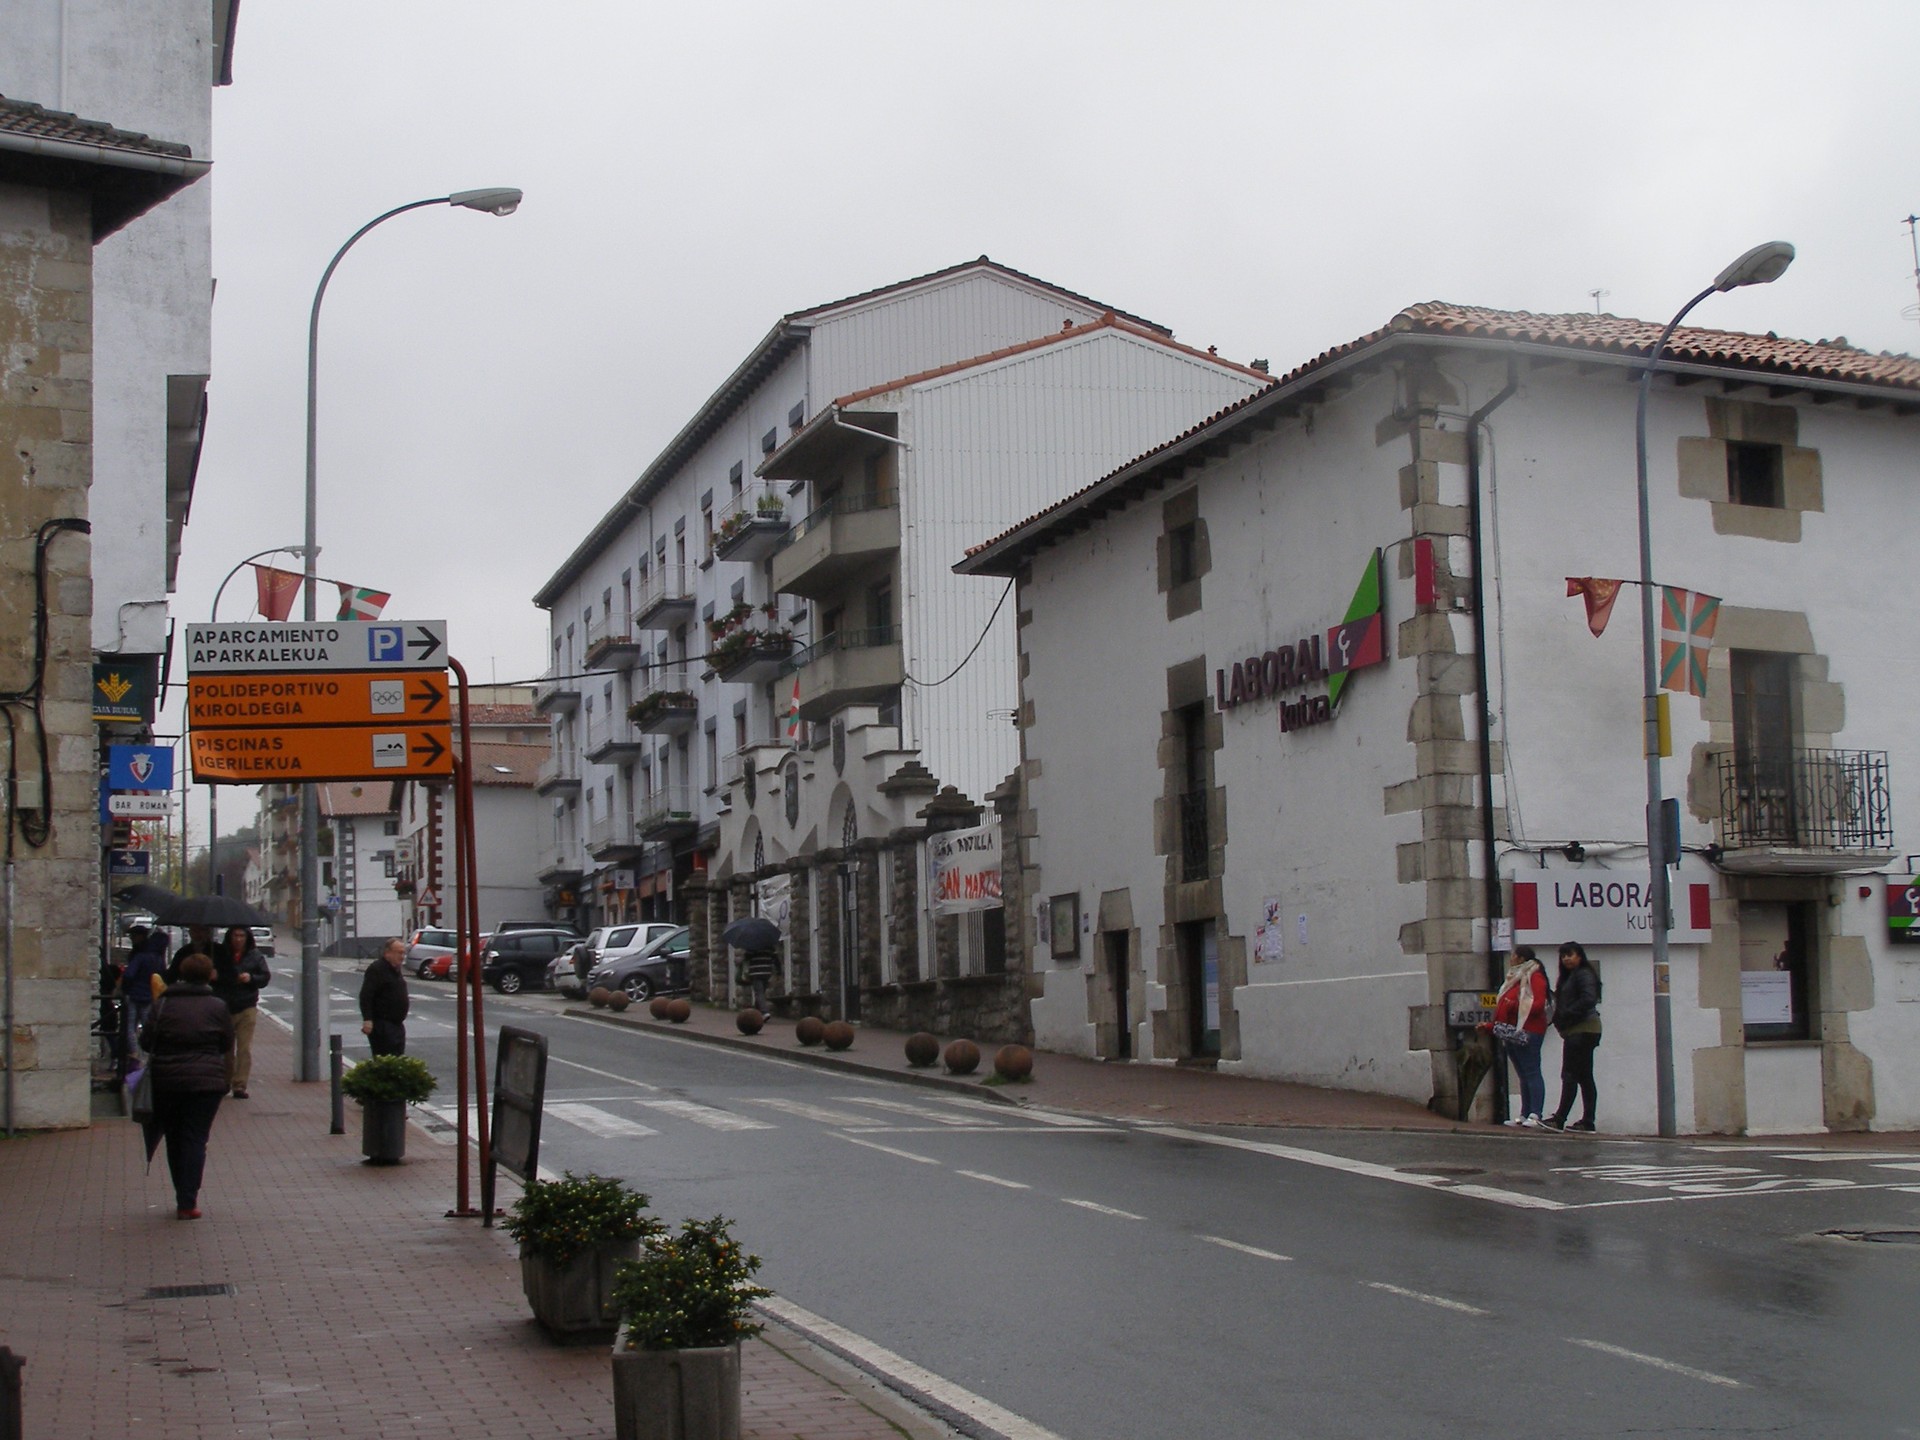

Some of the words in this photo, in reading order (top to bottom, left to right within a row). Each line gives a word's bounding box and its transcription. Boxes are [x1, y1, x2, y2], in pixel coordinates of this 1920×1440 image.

[193, 629, 339, 644] APARCAMIENTO
[373, 630, 397, 659] P
[193, 648, 328, 663] APARKALEKUA
[1216, 634, 1329, 710] LABORAL
[194, 682, 339, 698] POLIDEPORTIVO
[194, 702, 303, 717] KIROLDEGIA
[1280, 695, 1330, 733] kutxa
[196, 737, 283, 751] PISCINAS
[200, 756, 302, 770] IGERILEKUA
[115, 801, 131, 809] BAR
[140, 801, 167, 810] ROMAN
